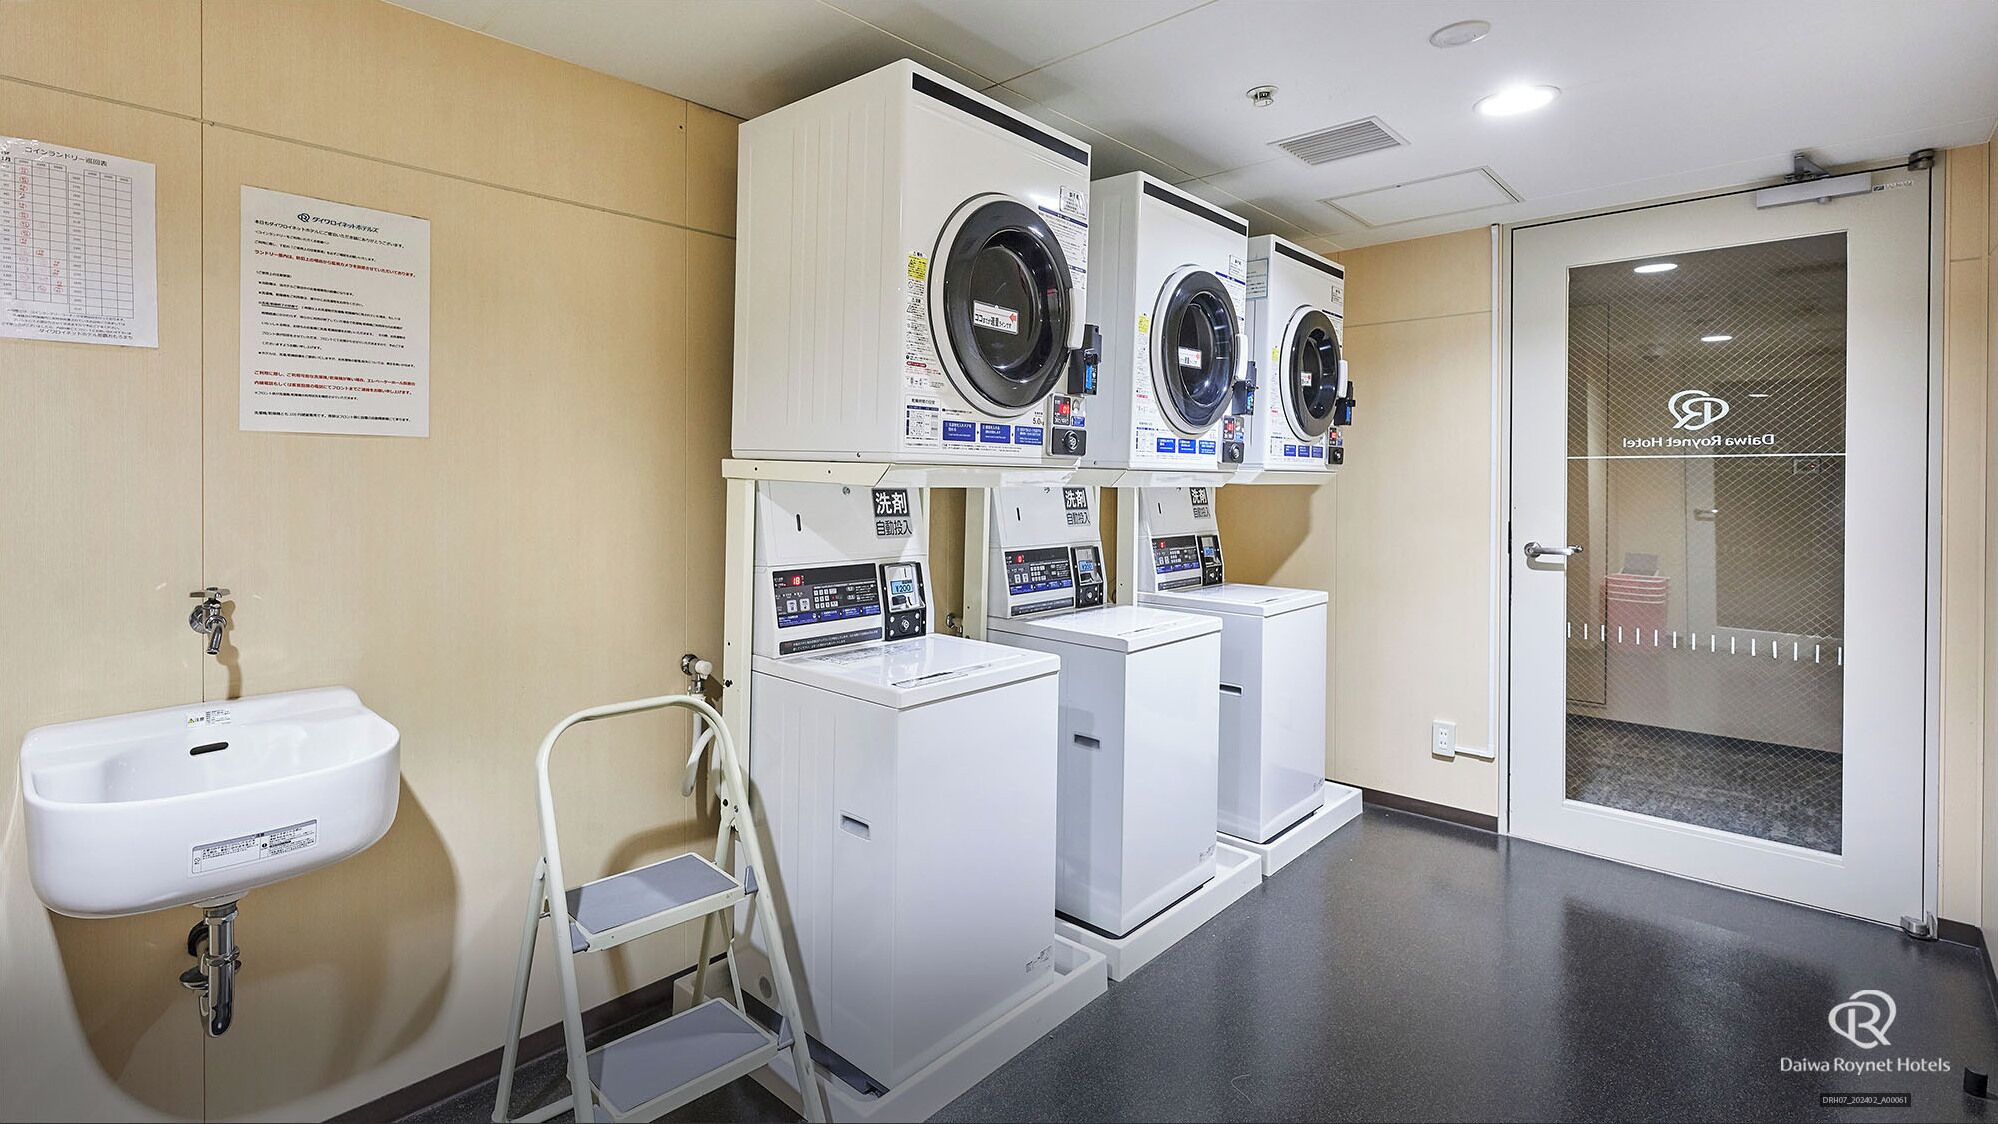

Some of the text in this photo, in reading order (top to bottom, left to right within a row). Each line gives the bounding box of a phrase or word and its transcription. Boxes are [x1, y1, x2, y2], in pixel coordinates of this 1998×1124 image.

[312, 216, 380, 234] ダイワロイネットホテルズ
[875, 491, 908, 515] 洗剤
[1065, 489, 1088, 509] 洗剤
[1191, 487, 1209, 504] 洗剤
[1066, 511, 1091, 526] 自動投入
[876, 519, 913, 537] 自動投入
[895, 584, 912, 594] ¥200
